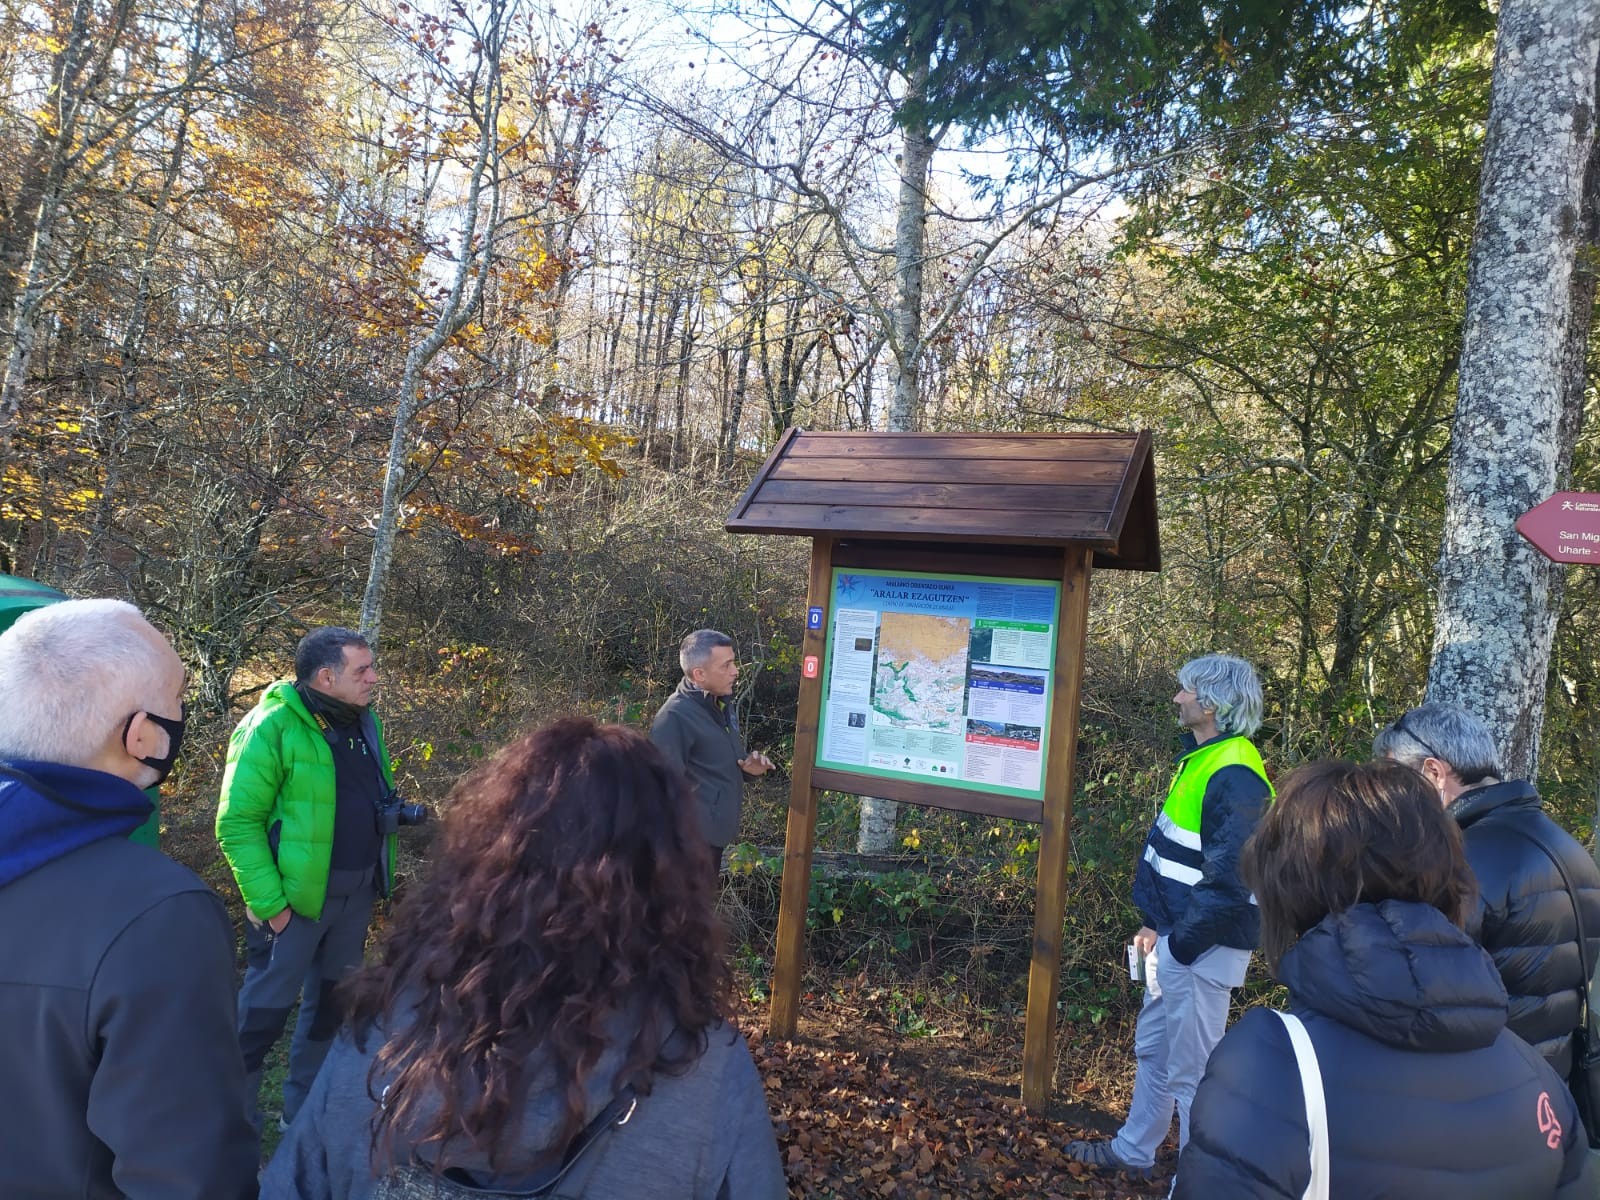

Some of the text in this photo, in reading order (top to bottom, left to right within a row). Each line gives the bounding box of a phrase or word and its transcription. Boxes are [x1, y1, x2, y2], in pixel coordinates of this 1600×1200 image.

[1559, 530, 1579, 540] San
[1558, 545, 1591, 555] Uharte
[811, 613, 819, 624] 0
[807, 662, 814, 673] 0
